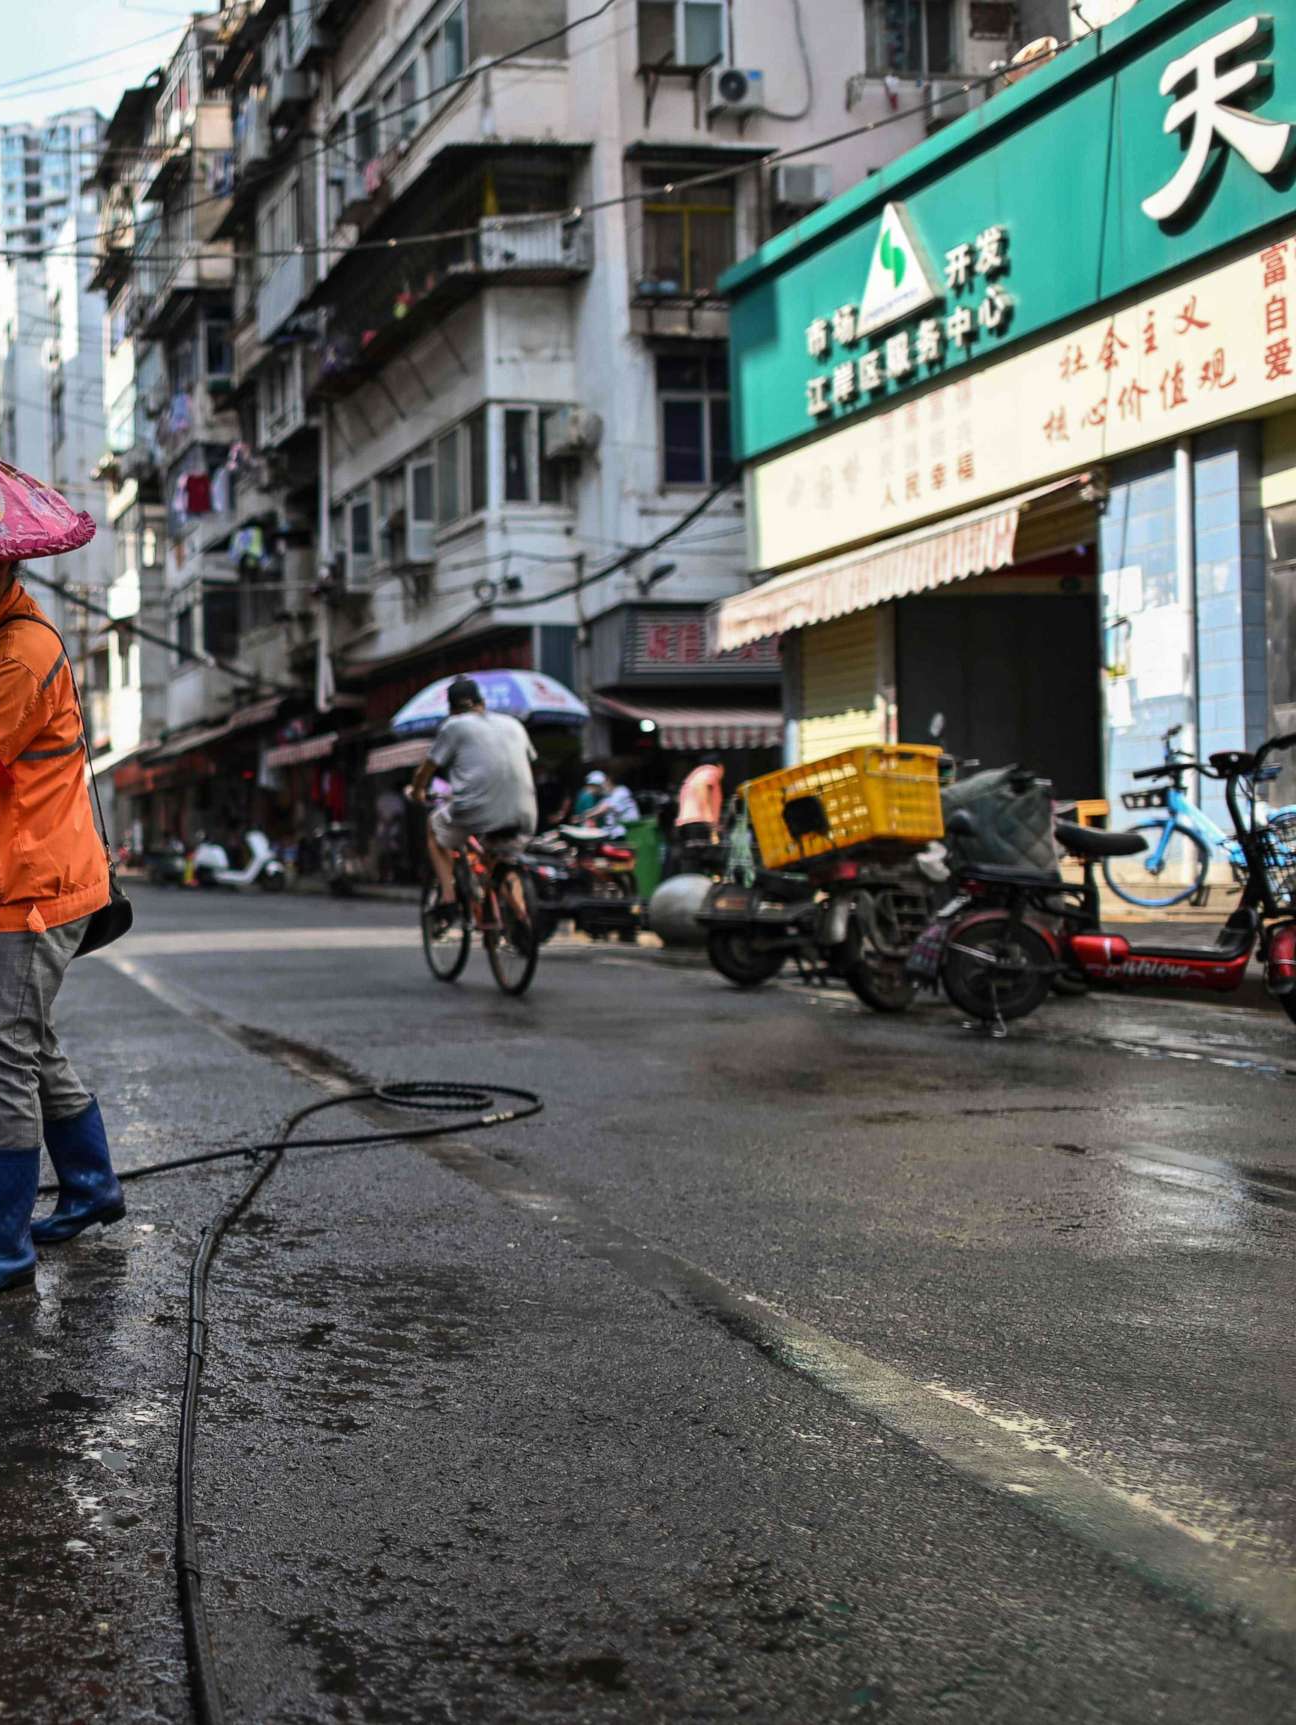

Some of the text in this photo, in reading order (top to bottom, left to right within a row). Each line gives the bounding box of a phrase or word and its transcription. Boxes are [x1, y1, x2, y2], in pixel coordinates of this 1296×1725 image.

[1141, 15, 1294, 221] 天
[944, 225, 1004, 289] 开发
[1059, 295, 1211, 380] 社会主义
[1042, 347, 1237, 443] 核心价值观
